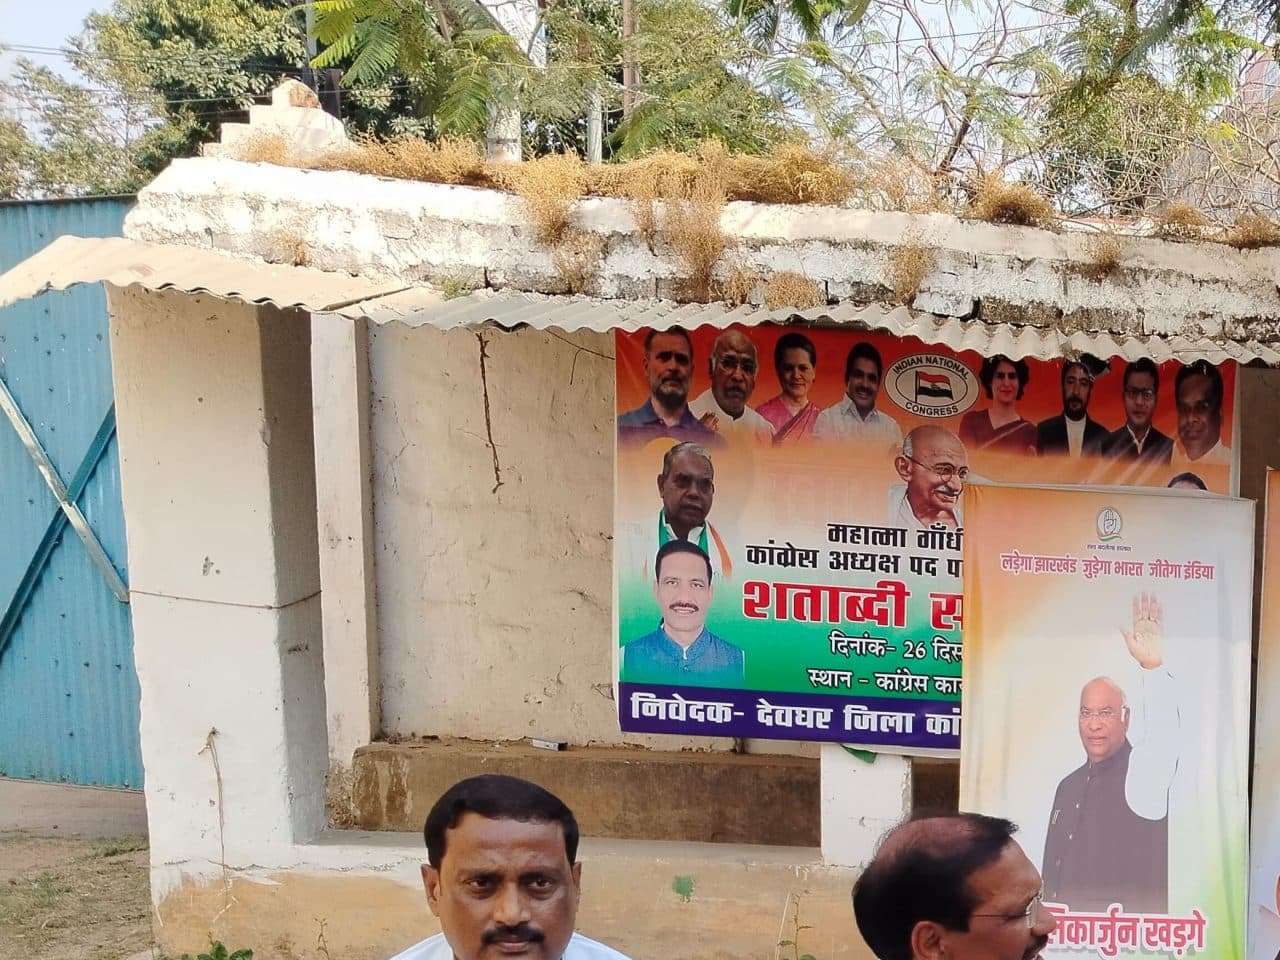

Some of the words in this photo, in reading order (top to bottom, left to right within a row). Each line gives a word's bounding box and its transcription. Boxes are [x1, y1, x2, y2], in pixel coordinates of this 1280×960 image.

[892, 356, 923, 374] INDIAN
[925, 355, 969, 380] NATIONAL
[905, 402, 958, 416] CONGRESS
[827, 523, 908, 548] महात्मा
[746, 539, 820, 569] कांग्रेस
[829, 550, 901, 574] अध्यक्ष
[910, 556, 939, 577] पद
[947, 558, 963, 578] प
[1001, 551, 1033, 574] लड़ेगा
[1034, 555, 1077, 573] झारखंड
[1082, 556, 1112, 579] जुड़ेगा
[1114, 560, 1144, 577] भारत
[1148, 558, 1182, 579] जीतेगा
[1183, 561, 1215, 580] इंडिया
[743, 580, 911, 628] शताब्दी
[903, 640, 927, 659] 26
[933, 636, 963, 663] दिस
[808, 668, 853, 688] स्थान
[875, 668, 929, 693] कांग्रेस
[933, 674, 962, 695] का
[756, 698, 833, 730] देवघर
[843, 704, 915, 734] जिला
[925, 707, 961, 737] कां
[1143, 909, 1206, 956] खड़गे
